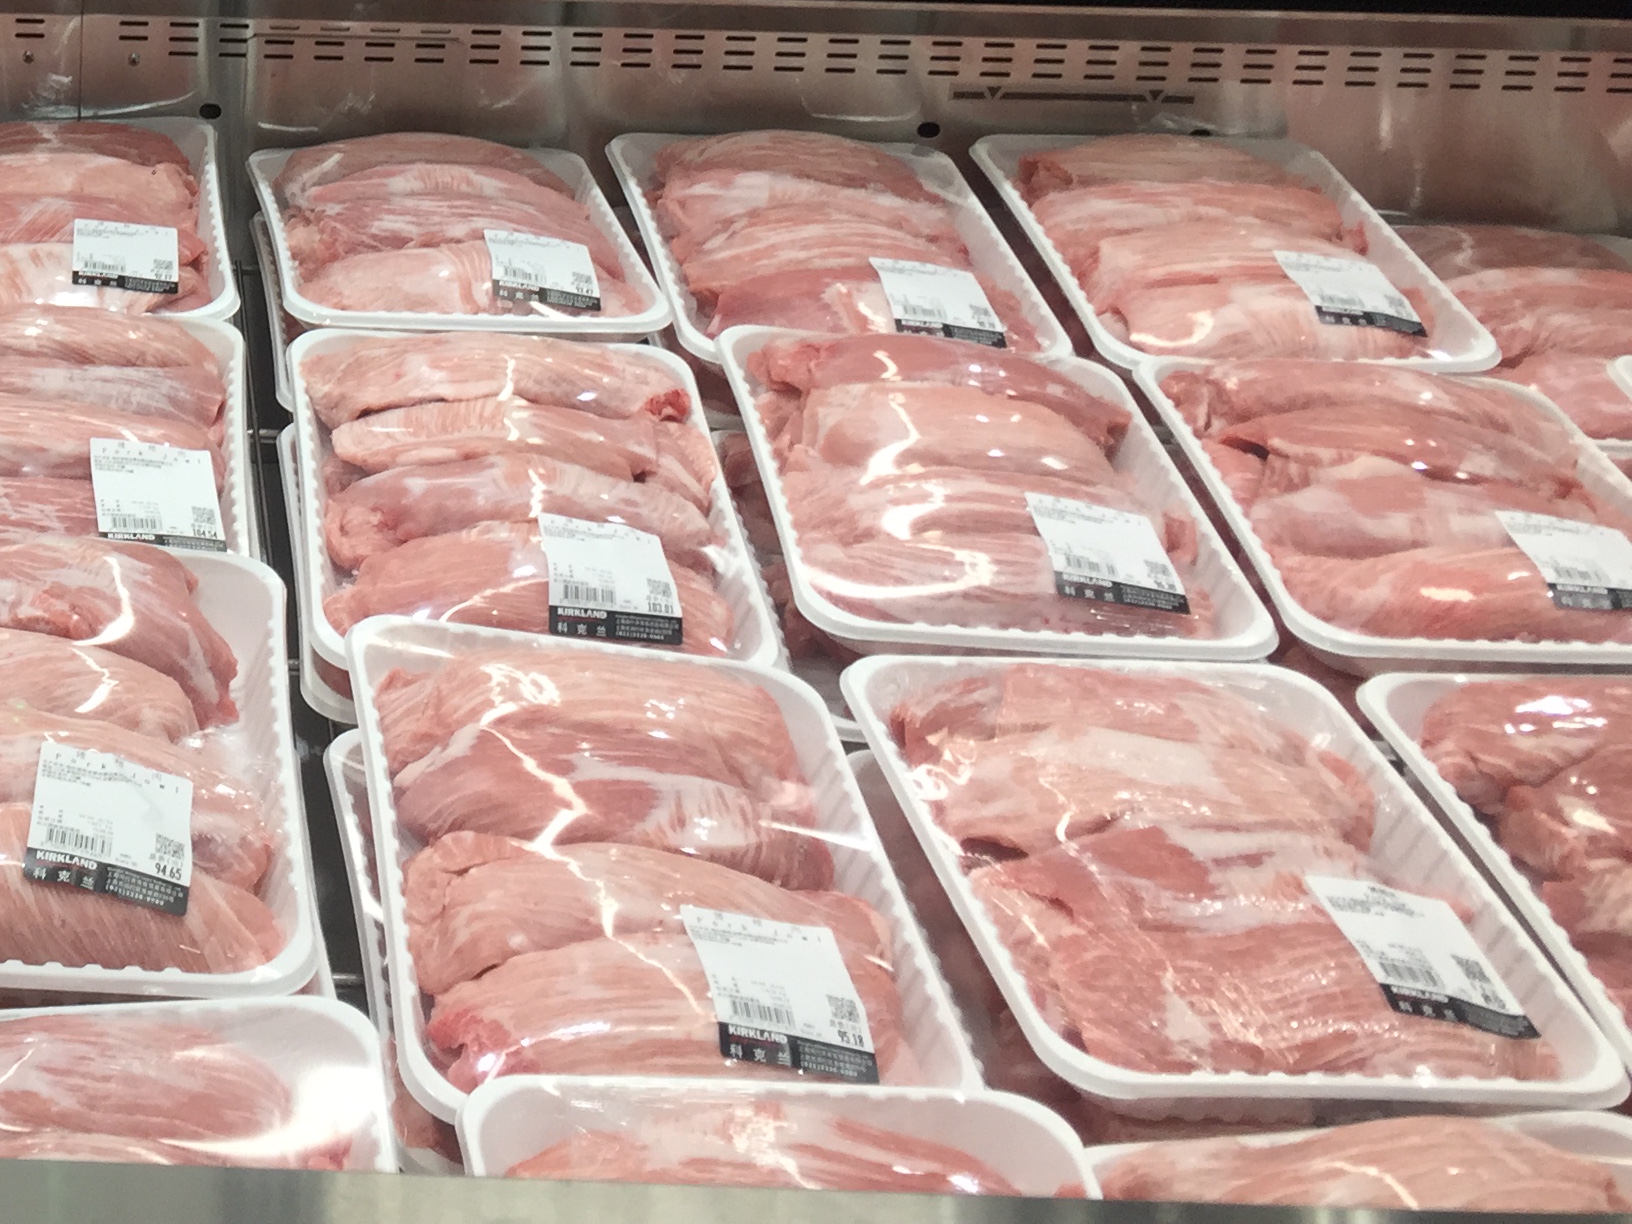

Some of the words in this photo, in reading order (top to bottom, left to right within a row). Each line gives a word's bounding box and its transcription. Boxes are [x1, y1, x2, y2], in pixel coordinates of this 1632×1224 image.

[558, 607, 608, 619] KIRKLAND
[36, 850, 98, 871] KIRKLAND
[728, 1025, 788, 1044] KIRKLAND
